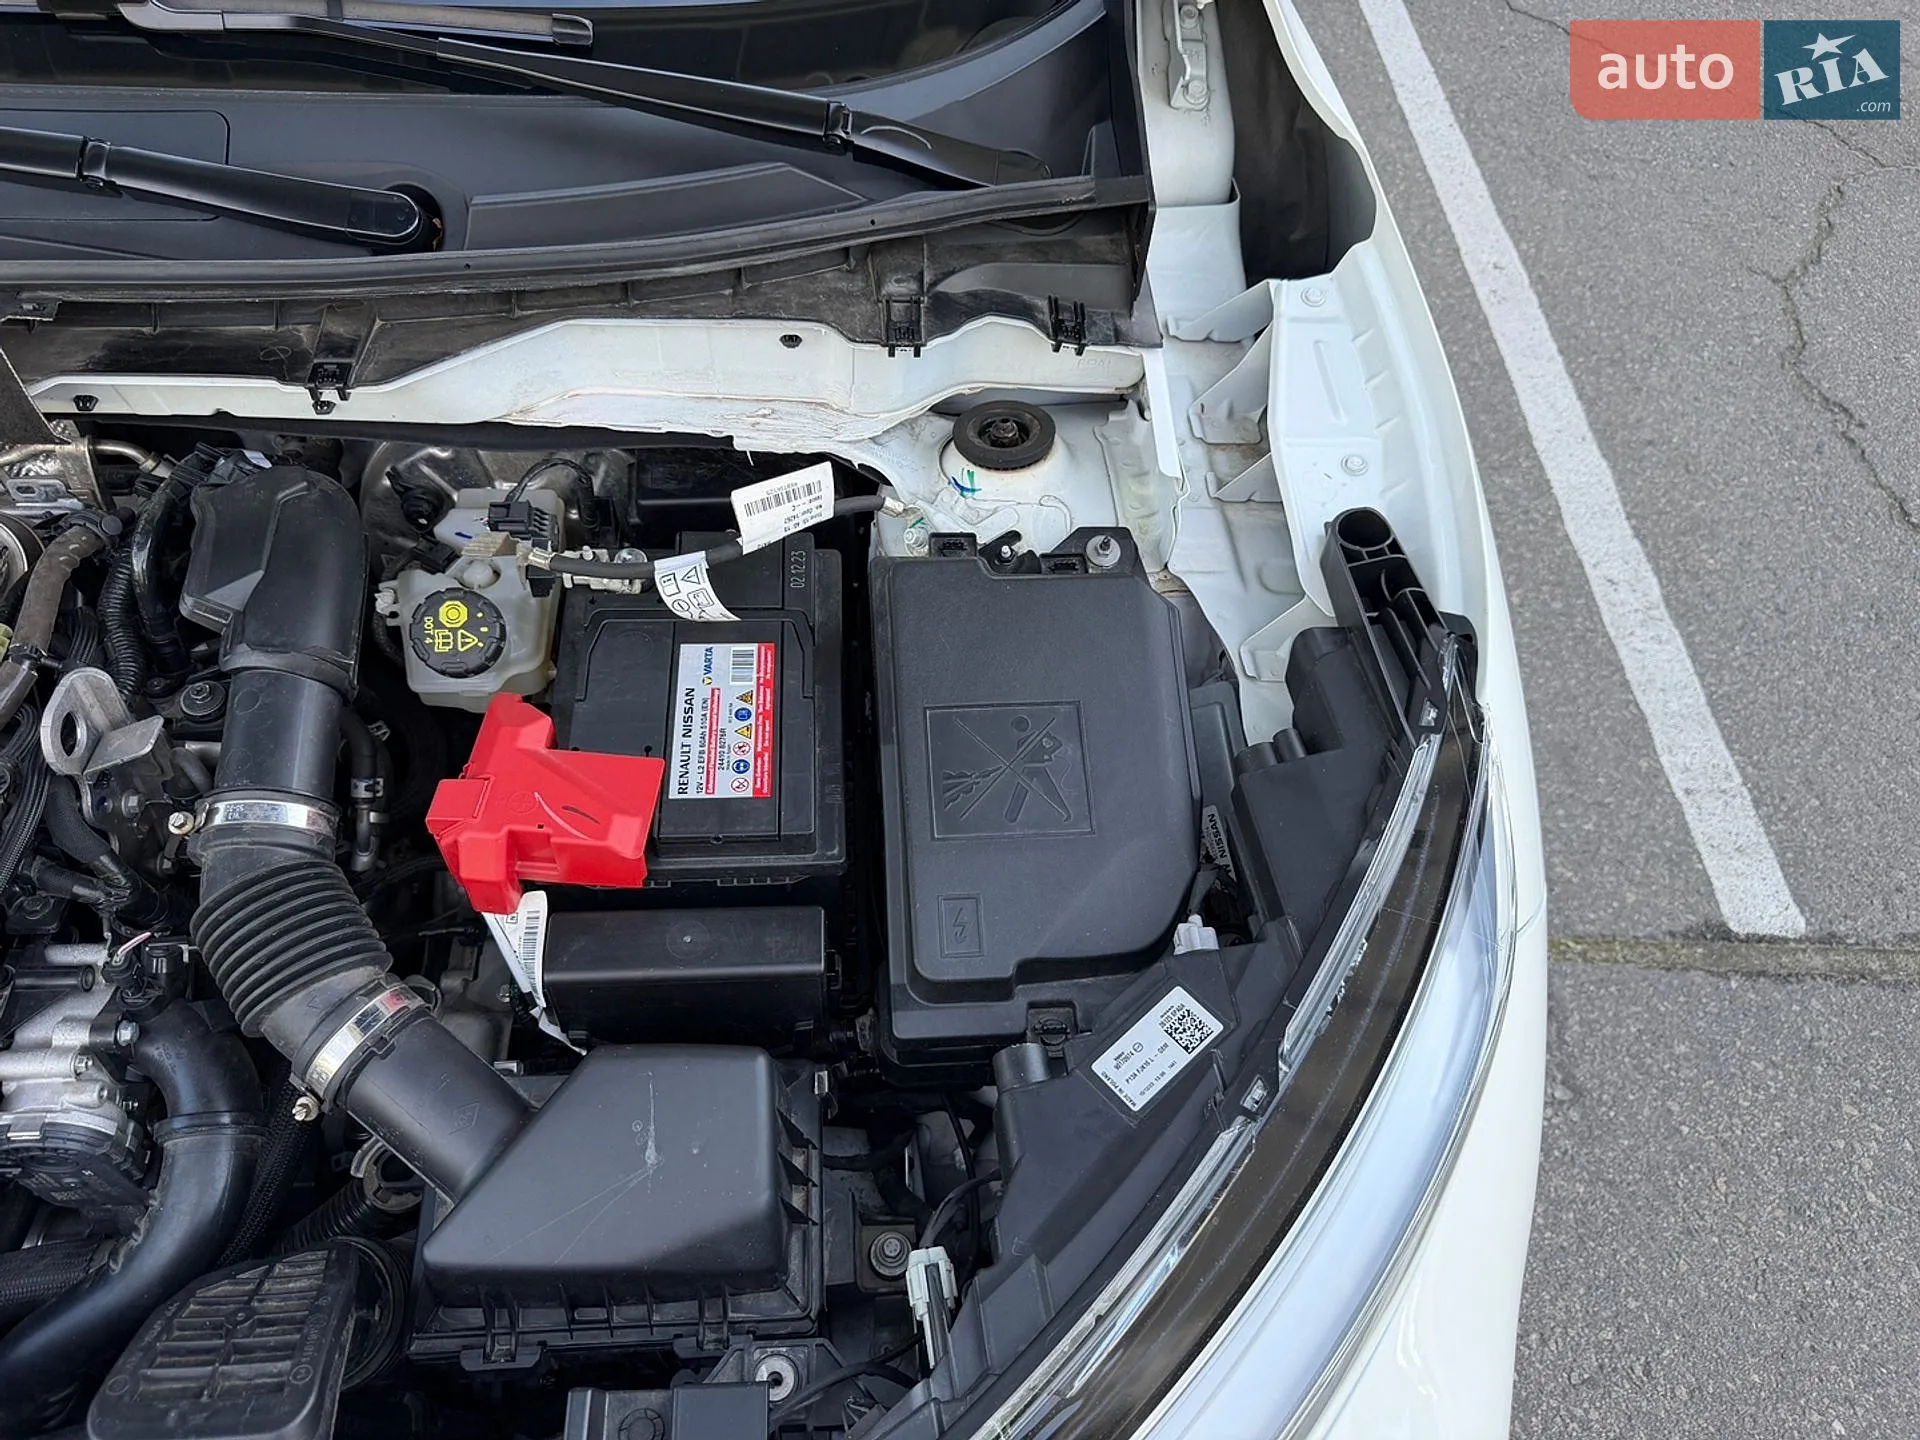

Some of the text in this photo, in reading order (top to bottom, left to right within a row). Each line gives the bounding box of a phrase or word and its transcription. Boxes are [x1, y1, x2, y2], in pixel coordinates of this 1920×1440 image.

[424, 616, 434, 635] DOT
[704, 646, 714, 675] VARTA
[678, 688, 695, 794] RENAULT NISSAN
